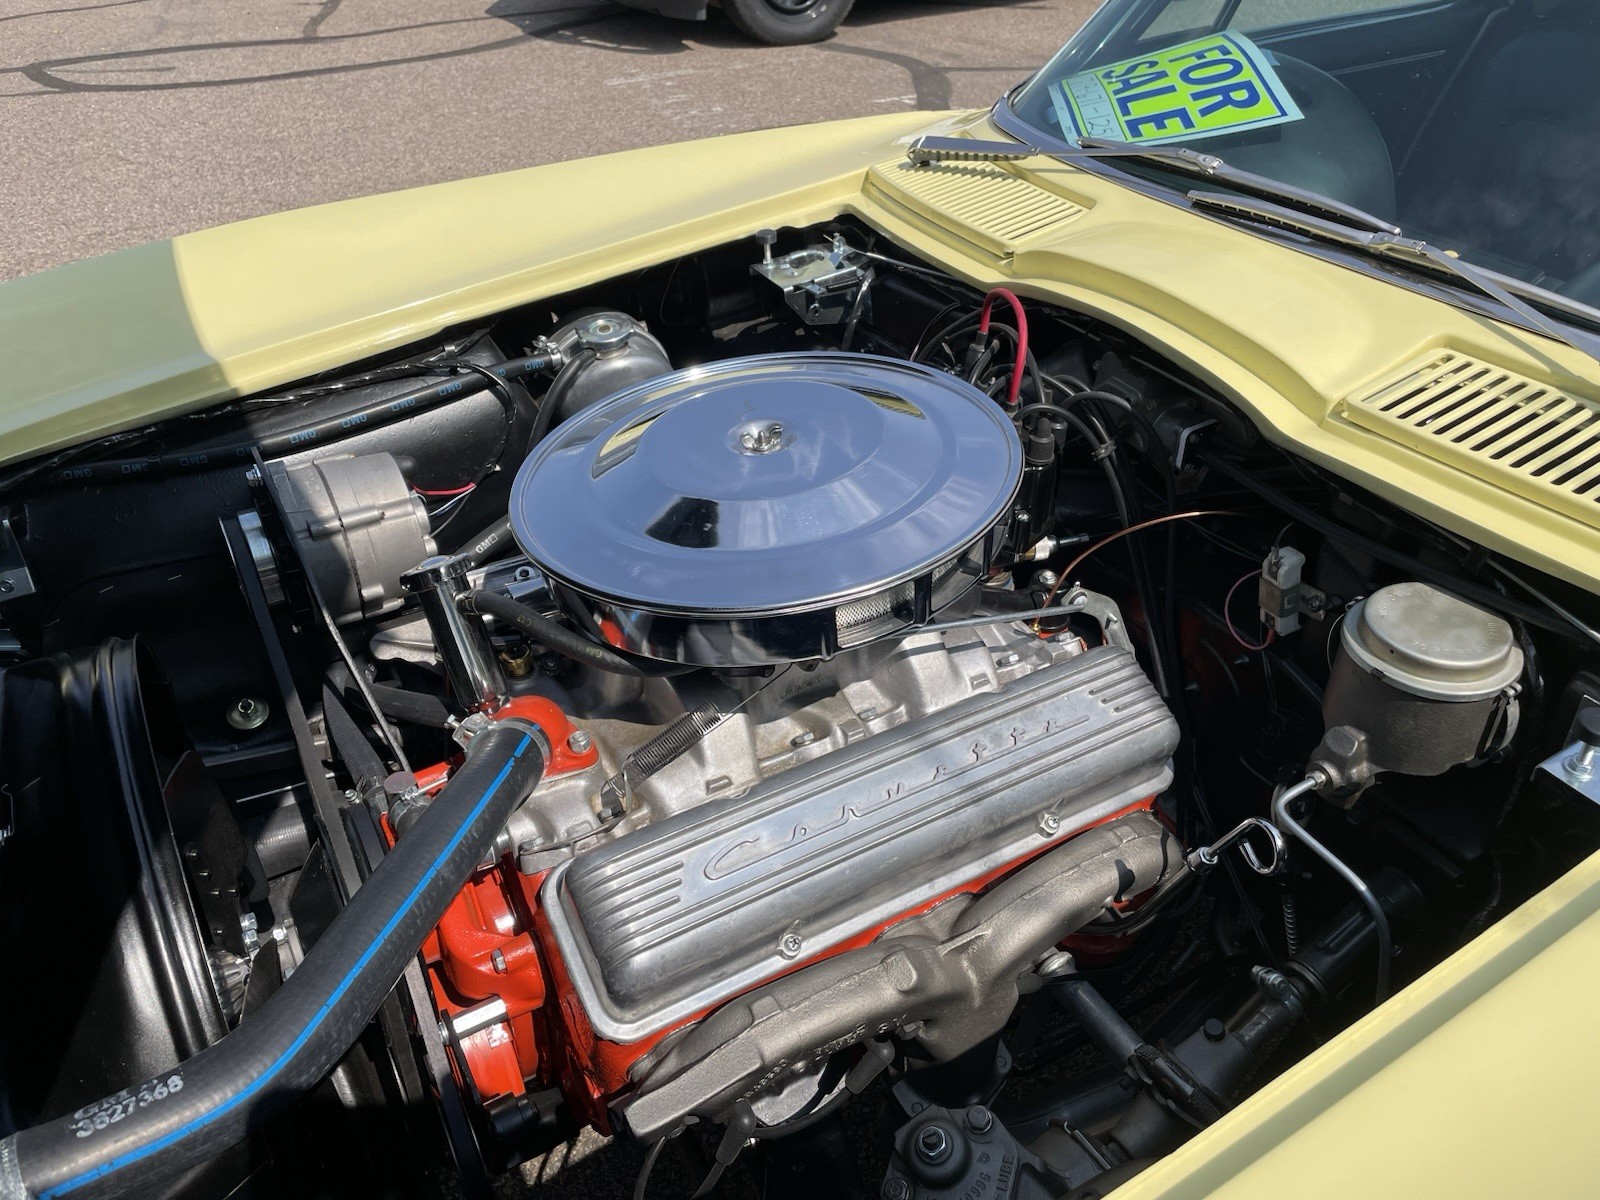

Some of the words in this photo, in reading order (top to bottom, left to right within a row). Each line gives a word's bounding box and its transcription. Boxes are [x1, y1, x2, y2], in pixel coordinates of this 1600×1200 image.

[1102, 60, 1196, 139] SALE
[1168, 44, 1261, 118] FOR
[74, 1074, 184, 1138] 3827368
